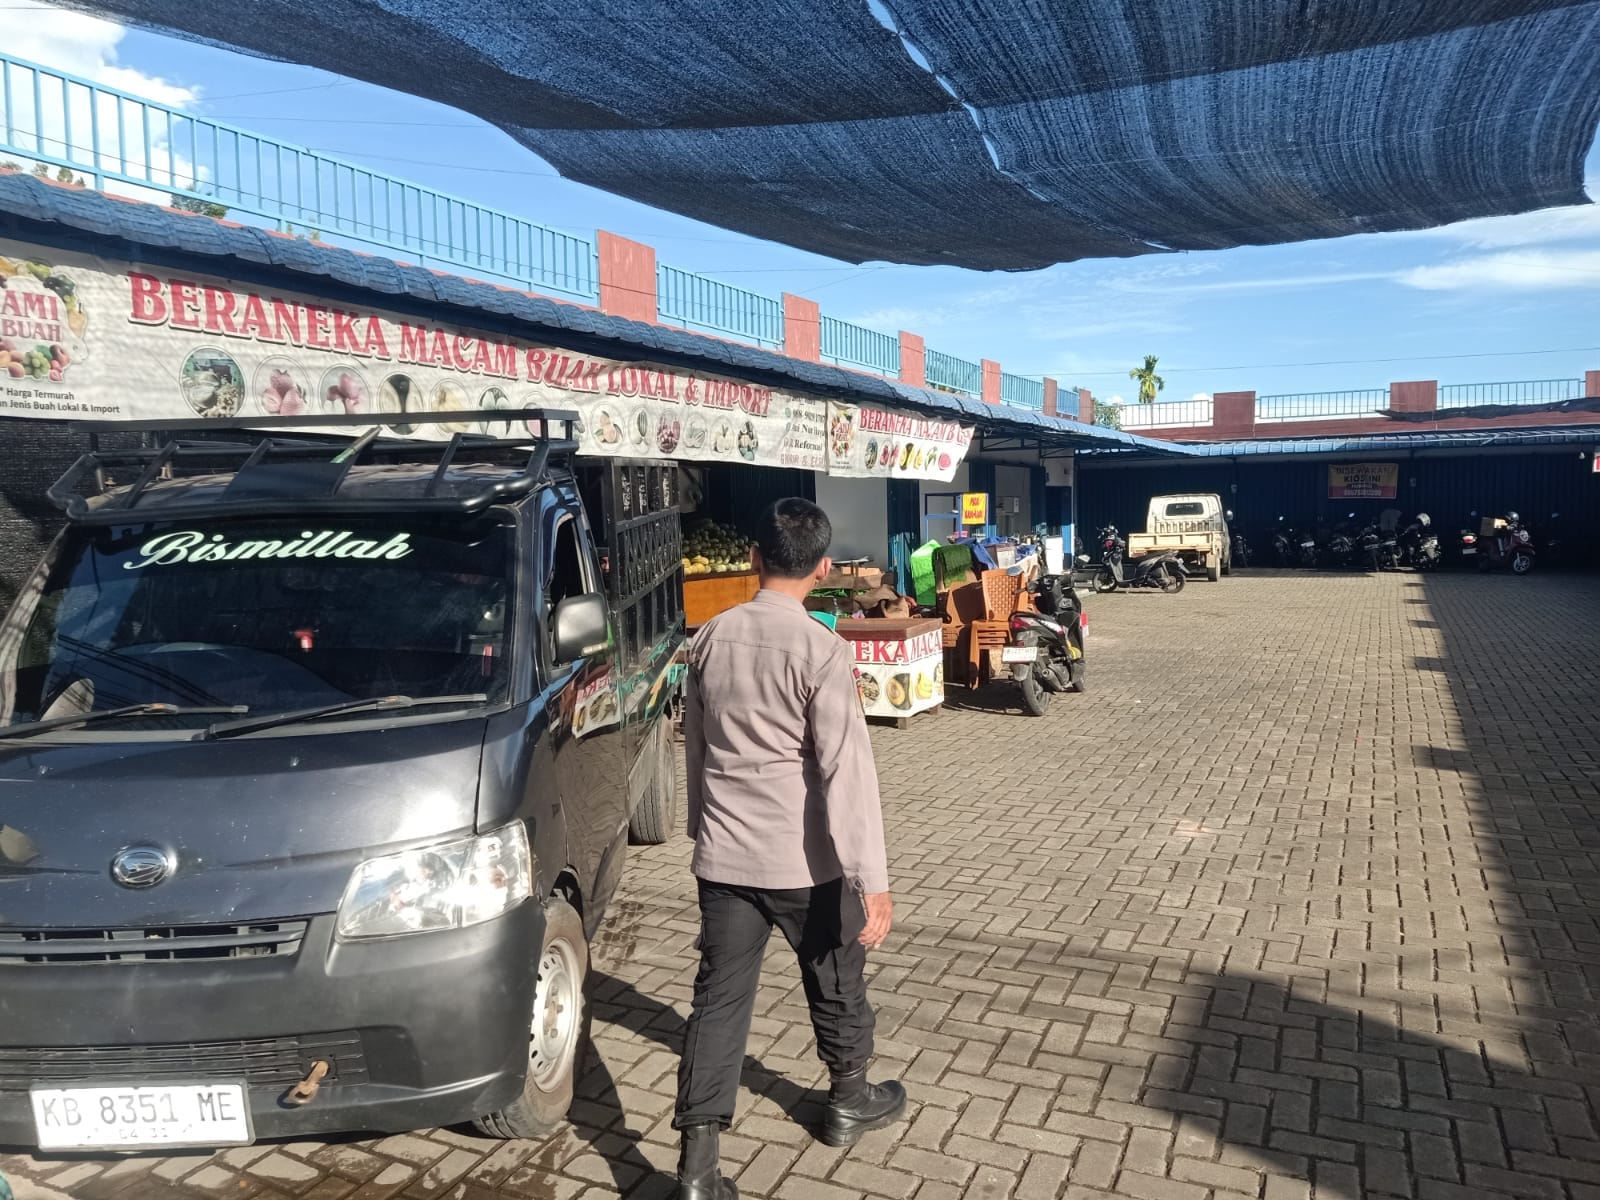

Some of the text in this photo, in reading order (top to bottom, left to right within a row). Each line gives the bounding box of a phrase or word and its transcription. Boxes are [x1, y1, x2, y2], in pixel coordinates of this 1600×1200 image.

[2, 318, 61, 342] BUAH
[128, 271, 772, 417] BERANEKA MACAM BUAH LOKAL & IMPORT
[6, 387, 75, 401] Harga Termurah
[10, 399, 32, 410] Jenis
[33, 401, 56, 411] Buah
[57, 403, 80, 413] Lokal
[81, 403, 89, 412] &
[91, 404, 120, 415] Import
[859, 407, 913, 436] BERANEKA
[123, 531, 414, 569] Bismillah
[41, 1092, 236, 1127] KB 8351 ME
